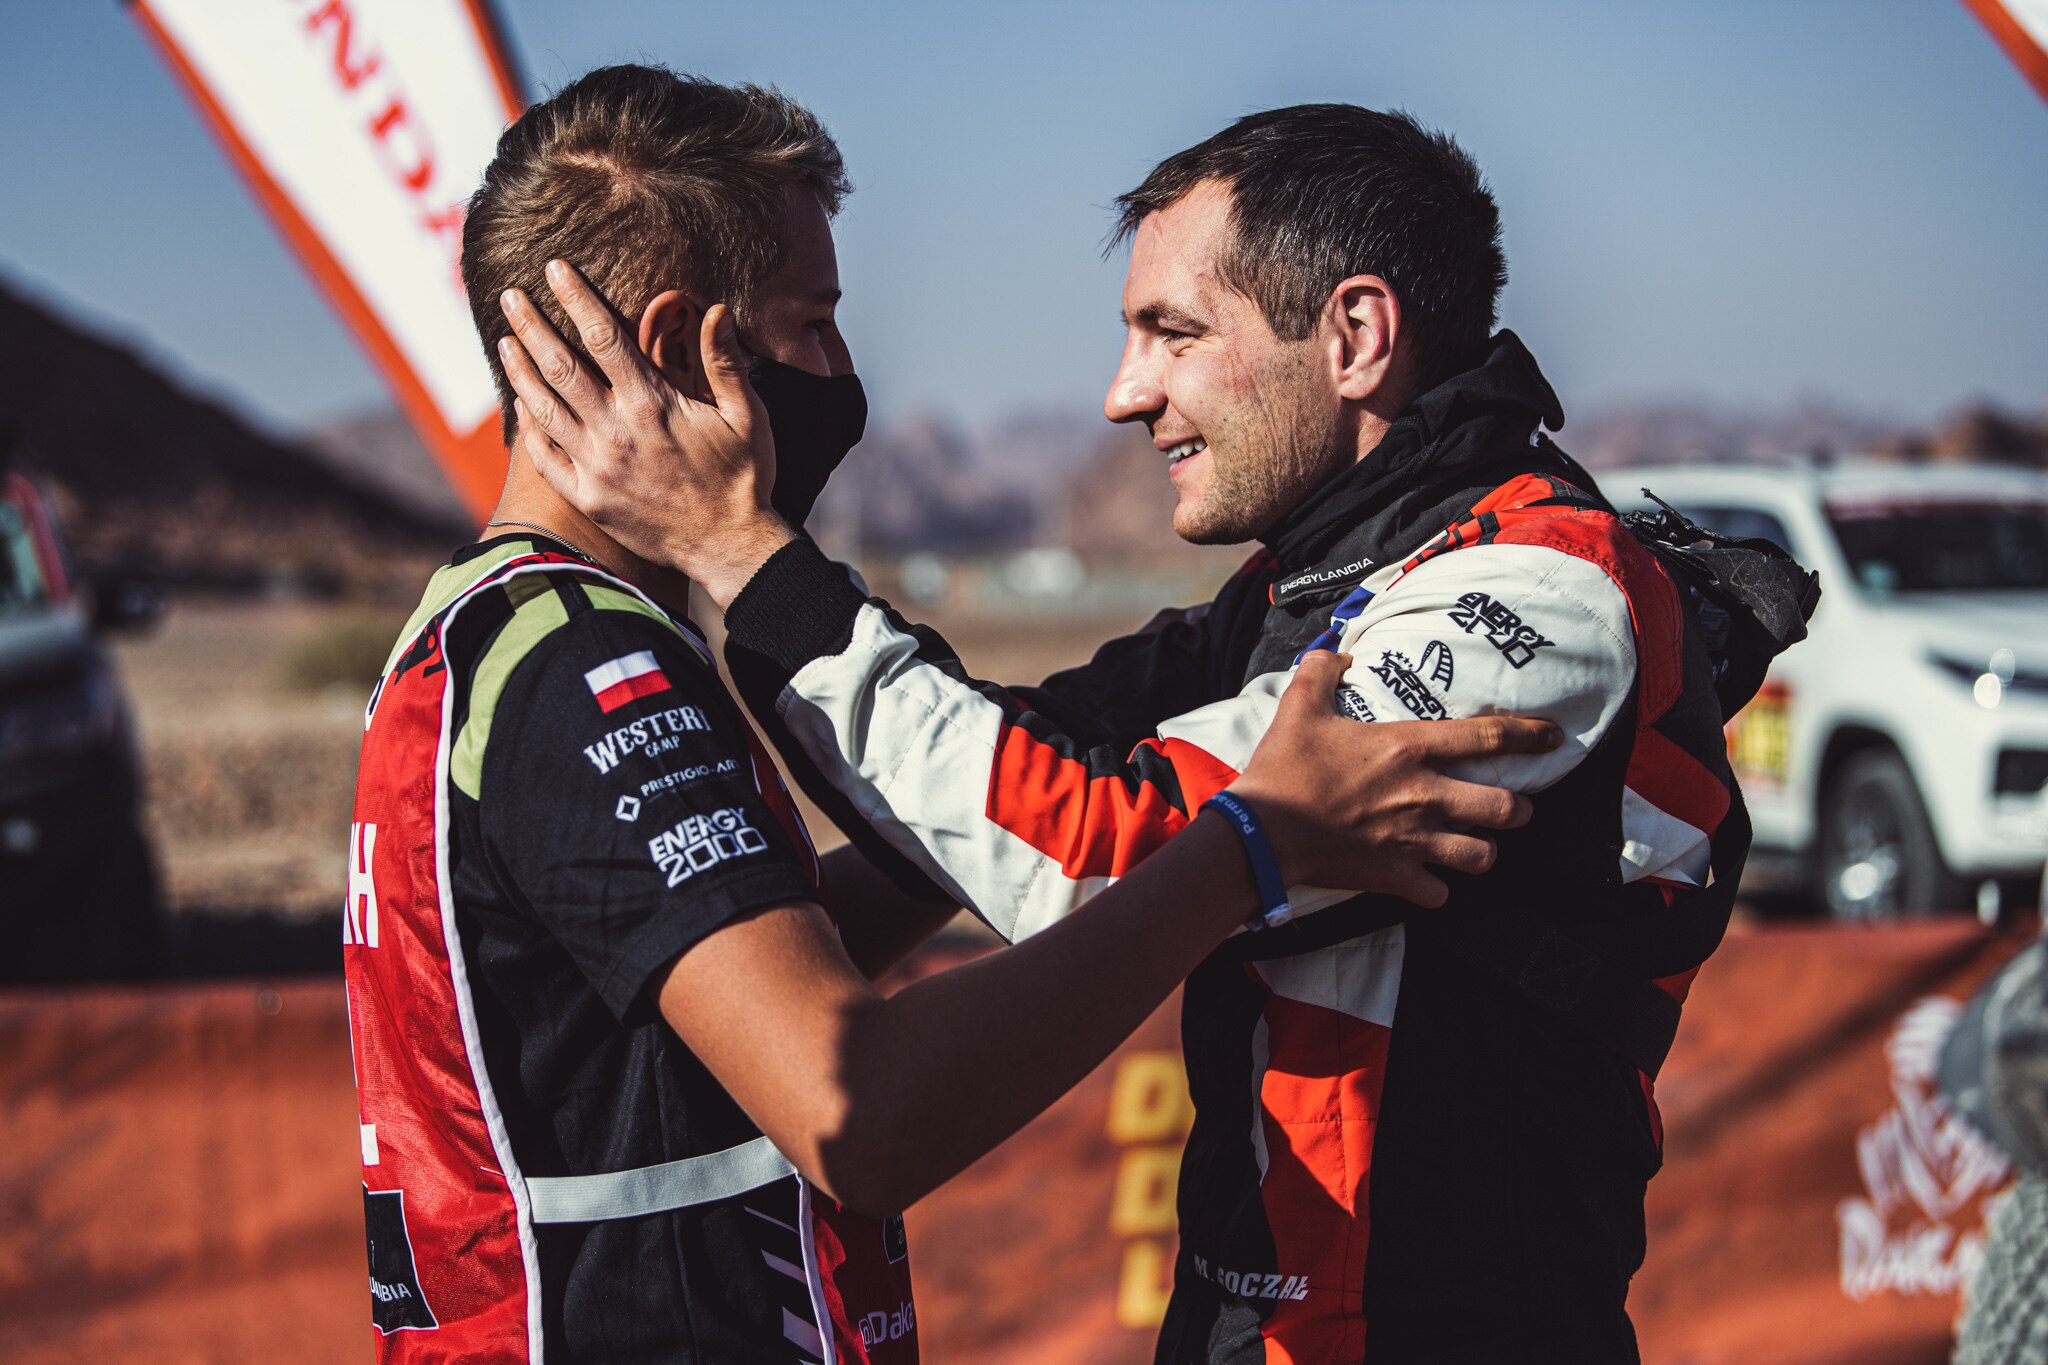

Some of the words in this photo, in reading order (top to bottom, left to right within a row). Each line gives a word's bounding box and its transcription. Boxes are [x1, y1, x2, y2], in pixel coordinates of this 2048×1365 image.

[1280, 557, 1374, 594] ENERGYLANDIA
[1447, 603, 1536, 670] 2000
[1455, 592, 1556, 650] ENERGY
[645, 735, 681, 758] CAMP
[648, 807, 748, 864] ENERGY
[658, 826, 768, 889] 2000
